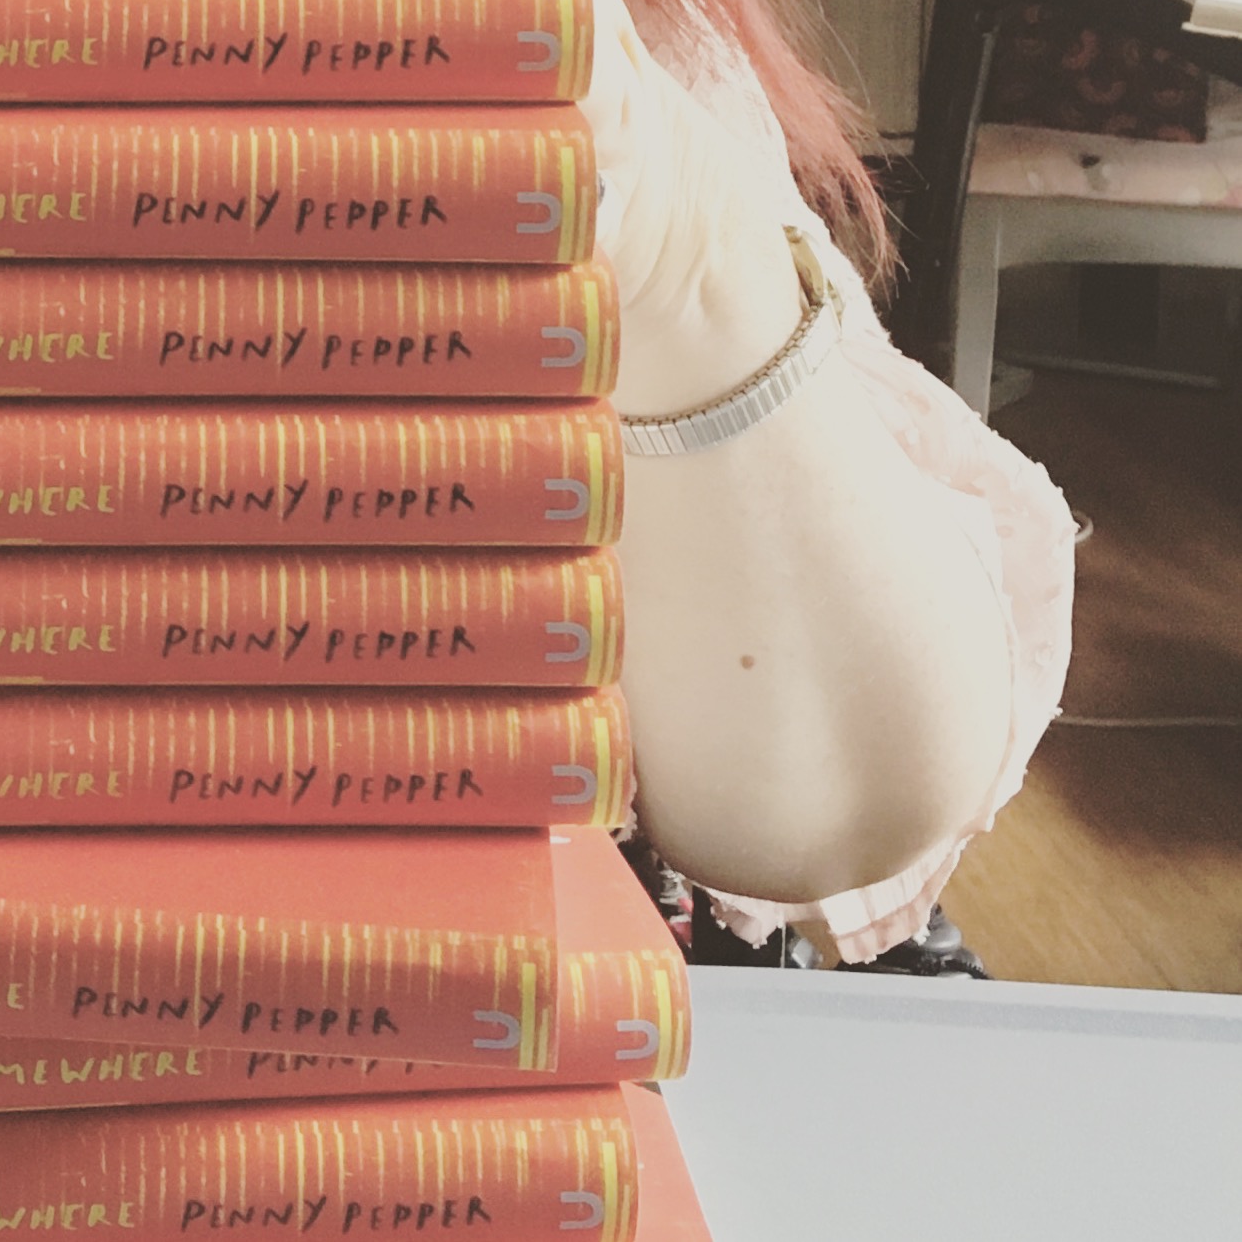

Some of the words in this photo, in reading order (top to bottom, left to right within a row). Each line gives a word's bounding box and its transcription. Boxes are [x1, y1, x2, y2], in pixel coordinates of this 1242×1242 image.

[143, 32, 288, 72] PENNY
[302, 35, 450, 75] PEPPER
[133, 190, 280, 231] PENNY
[295, 195, 447, 233] PEPPER
[160, 327, 307, 367] PENNY
[322, 331, 471, 370] PEPPER
[160, 479, 308, 520] PENNY
[324, 483, 474, 522] PEPPER
[162, 621, 310, 660] PENNY
[326, 625, 475, 663] PEPPER
[170, 765, 317, 804] PENNY
[332, 769, 482, 806] PEPPER
[72, 987, 224, 1028] PENNY
[242, 1002, 398, 1035] PEPPER
[181, 1195, 327, 1232] PENNY
[343, 1196, 491, 1234] PEPPER
